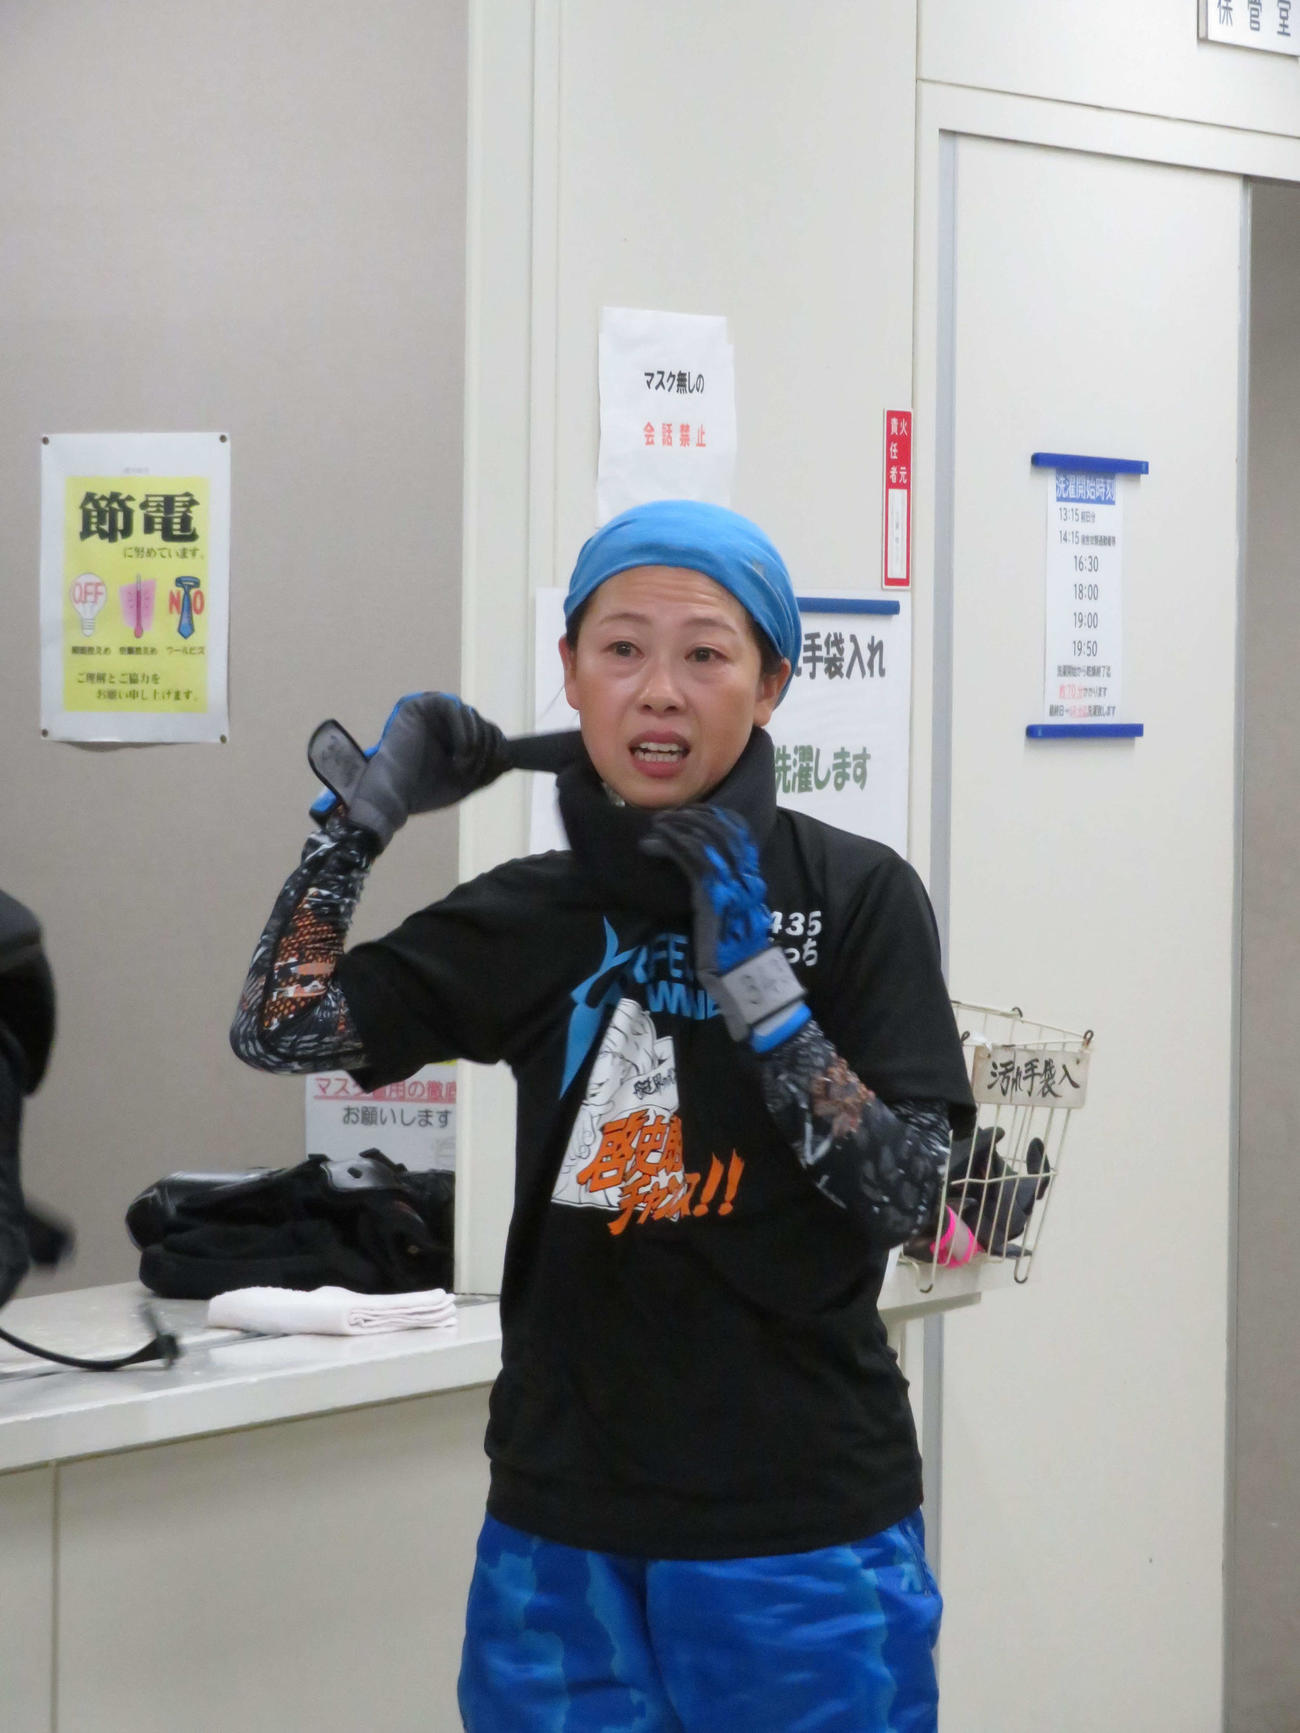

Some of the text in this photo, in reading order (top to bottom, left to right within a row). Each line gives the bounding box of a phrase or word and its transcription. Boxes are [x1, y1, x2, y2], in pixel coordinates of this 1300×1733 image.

[644, 370, 705, 394] マスク無しの
[643, 421, 706, 447] 会話禁止
[79, 491, 200, 543] 節電
[1059, 507, 1079, 522] 13:15
[1059, 530, 1080, 545] 14:15
[1073, 555, 1099, 573] 16:30
[73, 581, 105, 605] OFF
[1073, 583, 1099, 601] 18:00
[1073, 612, 1099, 629] 19:00
[794, 632, 886, 680] 手袋入れ
[1072, 640, 1098, 657] 19:50
[343, 1106, 452, 1128] お願いします
